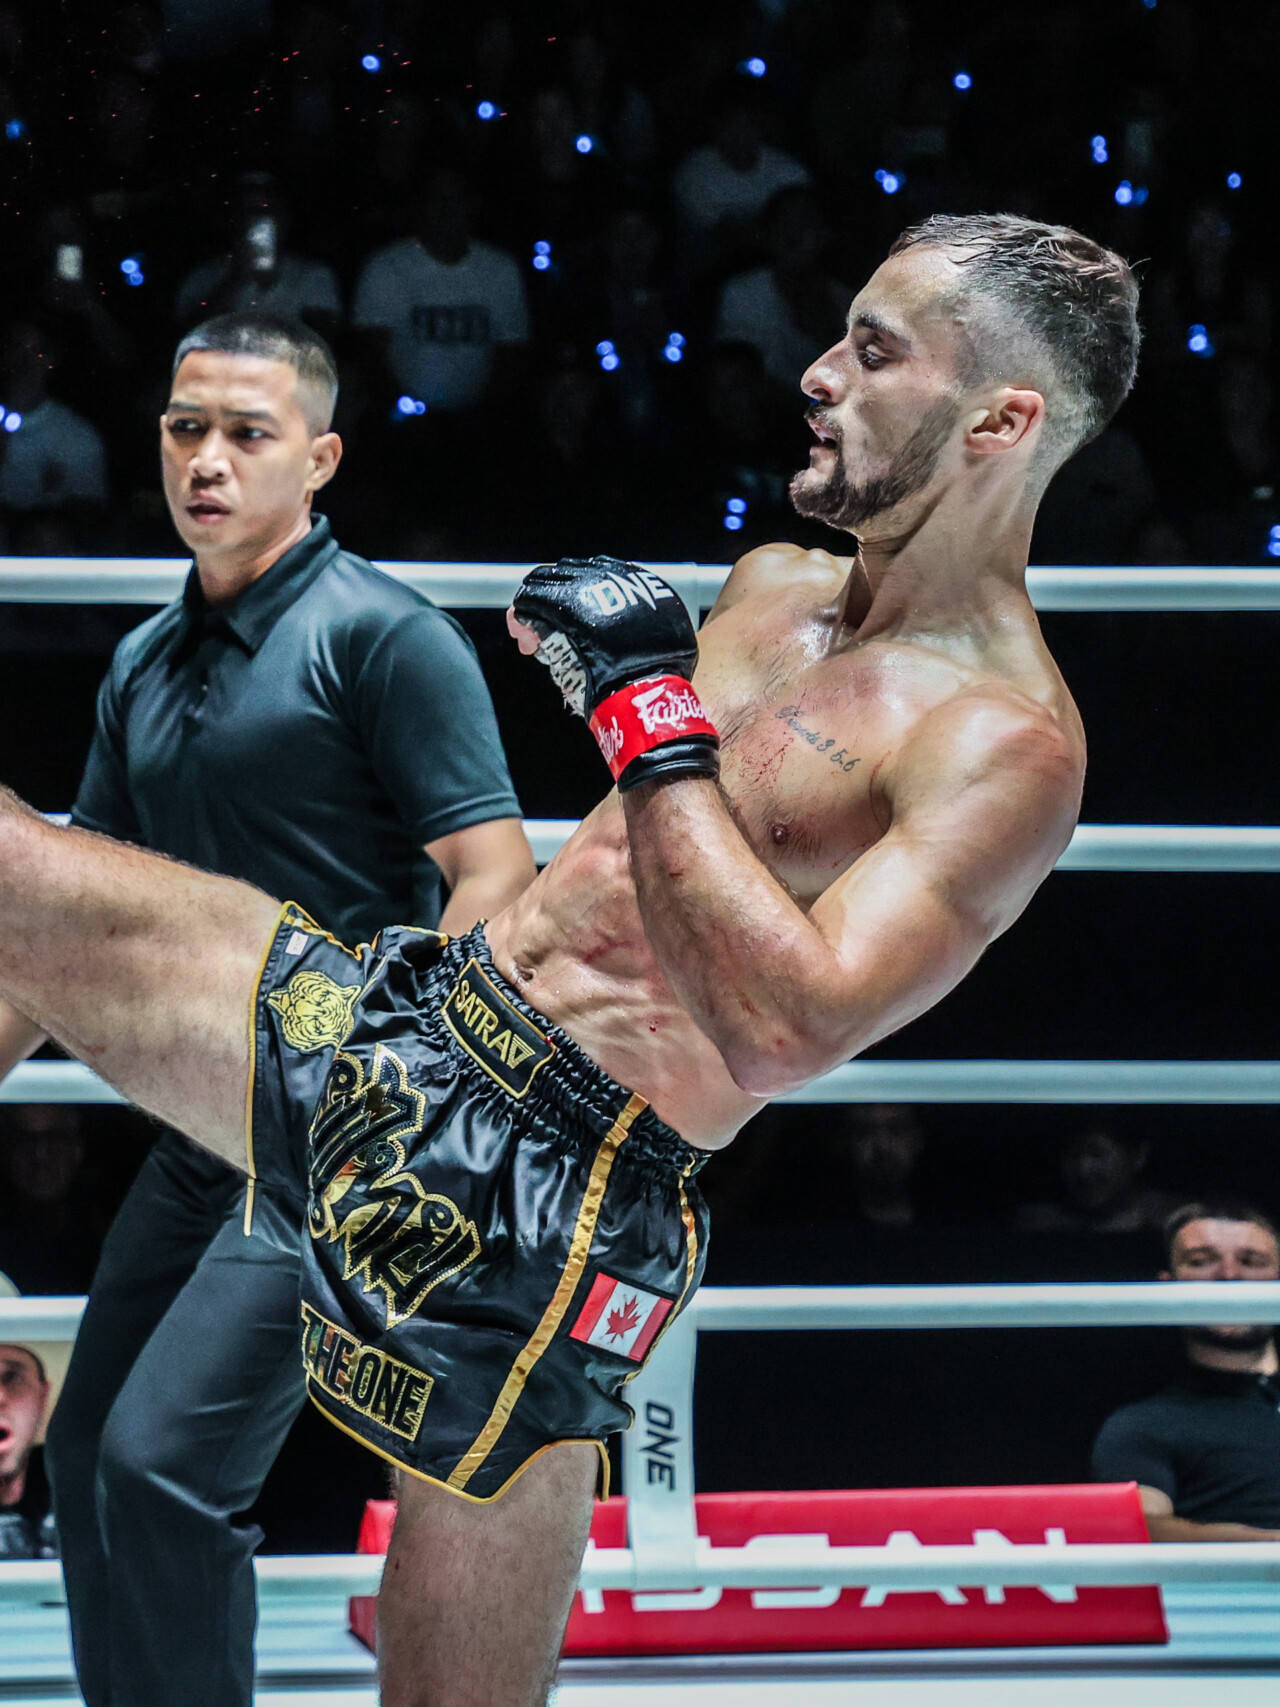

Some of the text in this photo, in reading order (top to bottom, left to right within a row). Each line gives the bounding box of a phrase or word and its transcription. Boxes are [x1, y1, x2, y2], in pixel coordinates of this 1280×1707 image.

[593, 571, 675, 616] ONE
[304, 1304, 428, 1434] THE ONE
[638, 1401, 682, 1492] ONE
